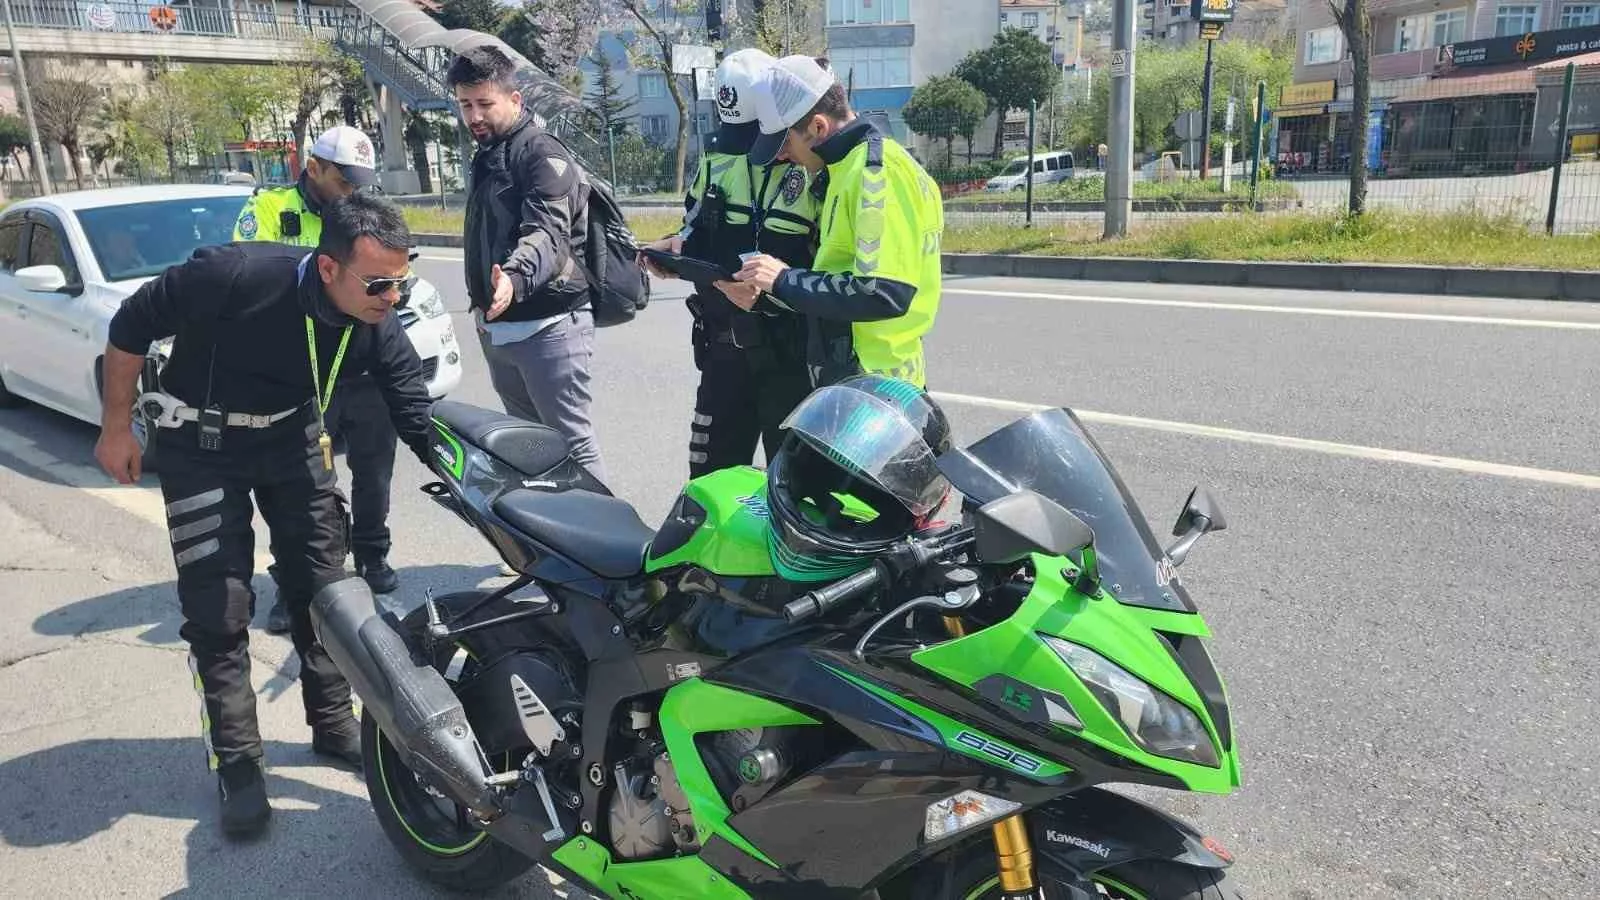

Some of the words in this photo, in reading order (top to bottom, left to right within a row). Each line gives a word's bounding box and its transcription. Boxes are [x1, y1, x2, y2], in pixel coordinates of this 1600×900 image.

[1515, 32, 1537, 60] efe
[956, 731, 1041, 774] 636
[1046, 829, 1111, 859] Kawasaki
